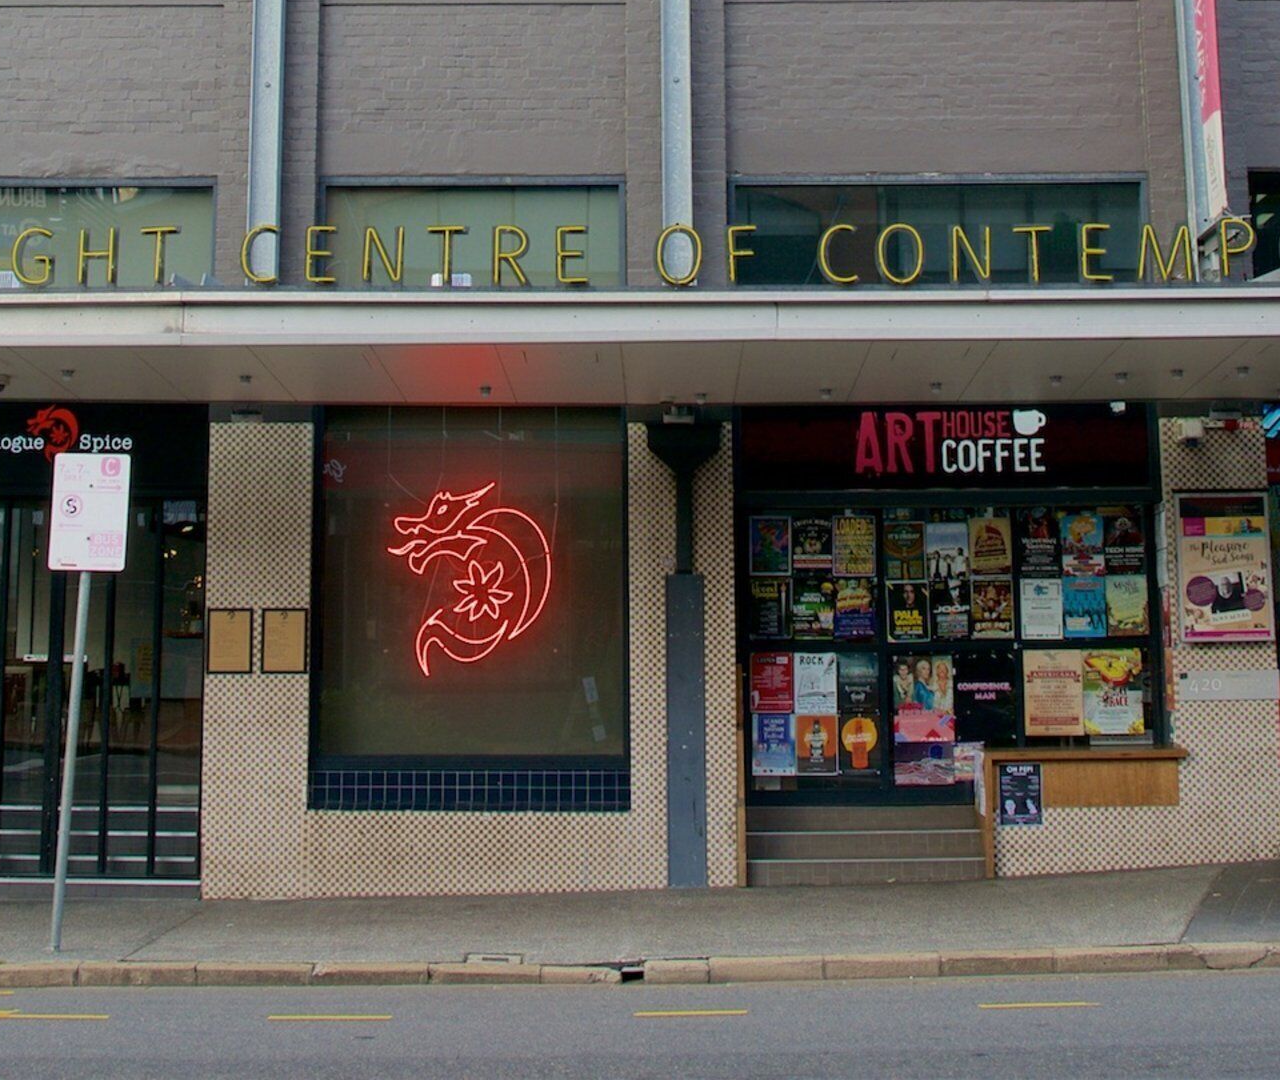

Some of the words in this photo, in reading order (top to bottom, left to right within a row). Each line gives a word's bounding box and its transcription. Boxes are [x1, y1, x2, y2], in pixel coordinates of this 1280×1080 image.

[240, 225, 589, 285] CENTRE
[655, 222, 756, 283] OF
[79, 433, 133, 454] Spice
[855, 411, 941, 474] ART
[942, 411, 1010, 438] HOUSE
[942, 438, 1047, 473] COFFEE
[1201, 540, 1248, 557] Pleasure
[1210, 554, 1228, 566] Sad
[1230, 552, 1255, 563] Songs
[799, 656, 824, 665] ROCK
[1189, 677, 1222, 694] 420
